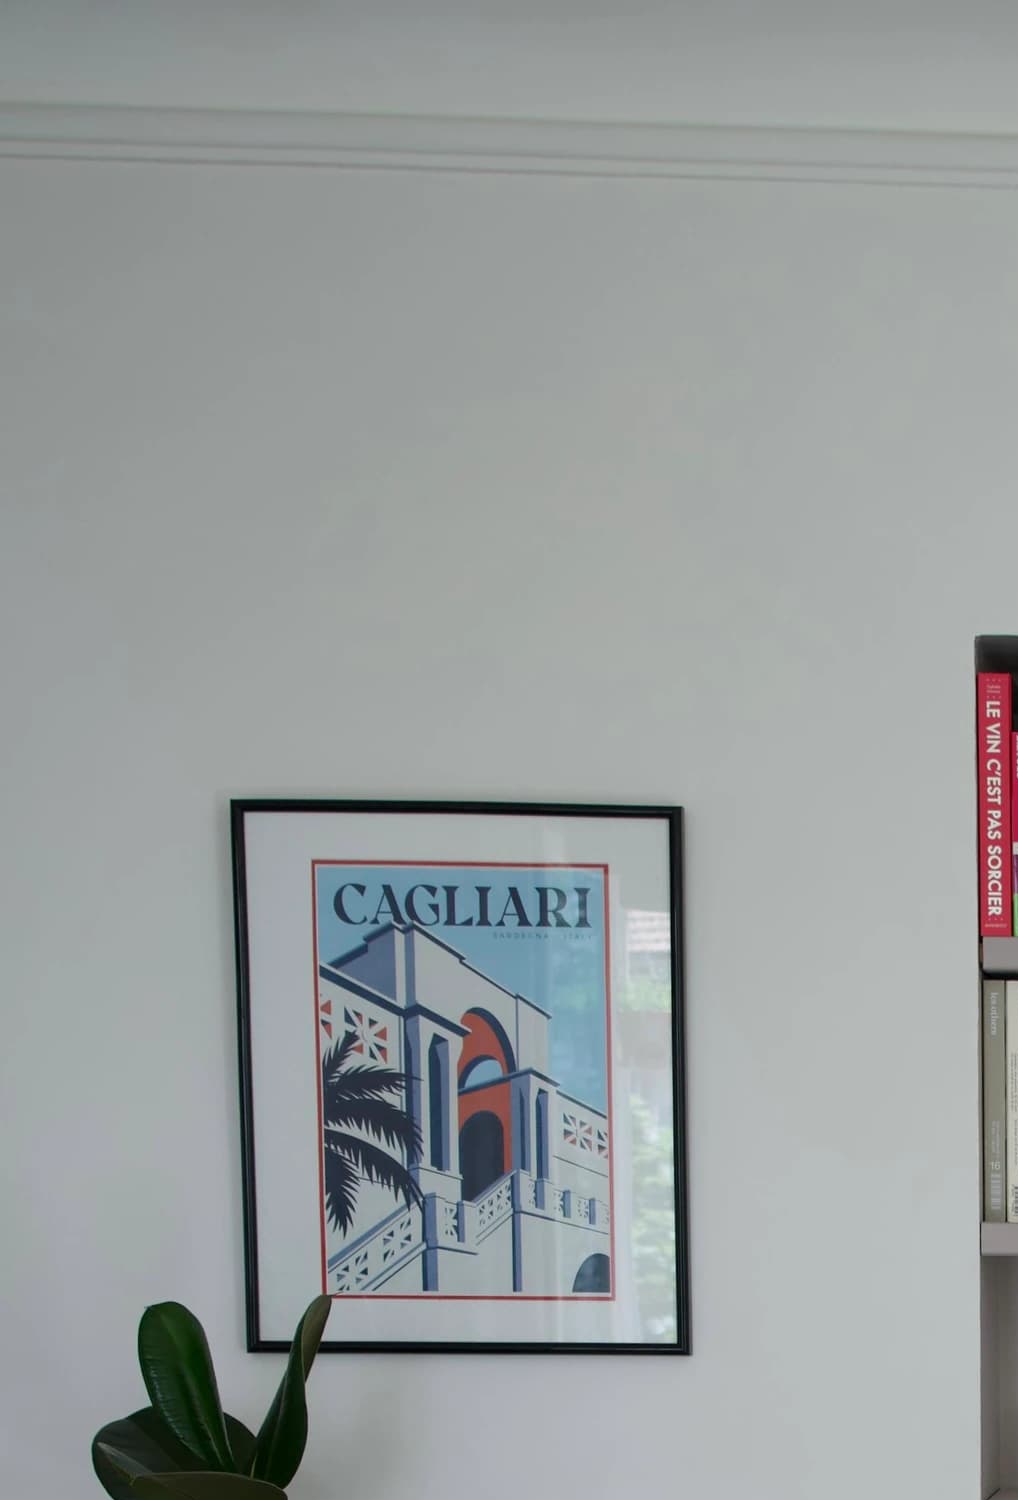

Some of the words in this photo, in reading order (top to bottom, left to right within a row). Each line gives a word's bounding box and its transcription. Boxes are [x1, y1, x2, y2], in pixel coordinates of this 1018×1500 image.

[985, 700, 1001, 719] LE
[985, 722, 1001, 754] VIN
[986, 758, 1002, 806] C'EST
[986, 809, 1002, 841] PAS
[987, 844, 1003, 917] SORCIER
[332, 882, 592, 928] CAGLIARI
[990, 991, 998, 1006] les
[990, 1006, 998, 1036] others
